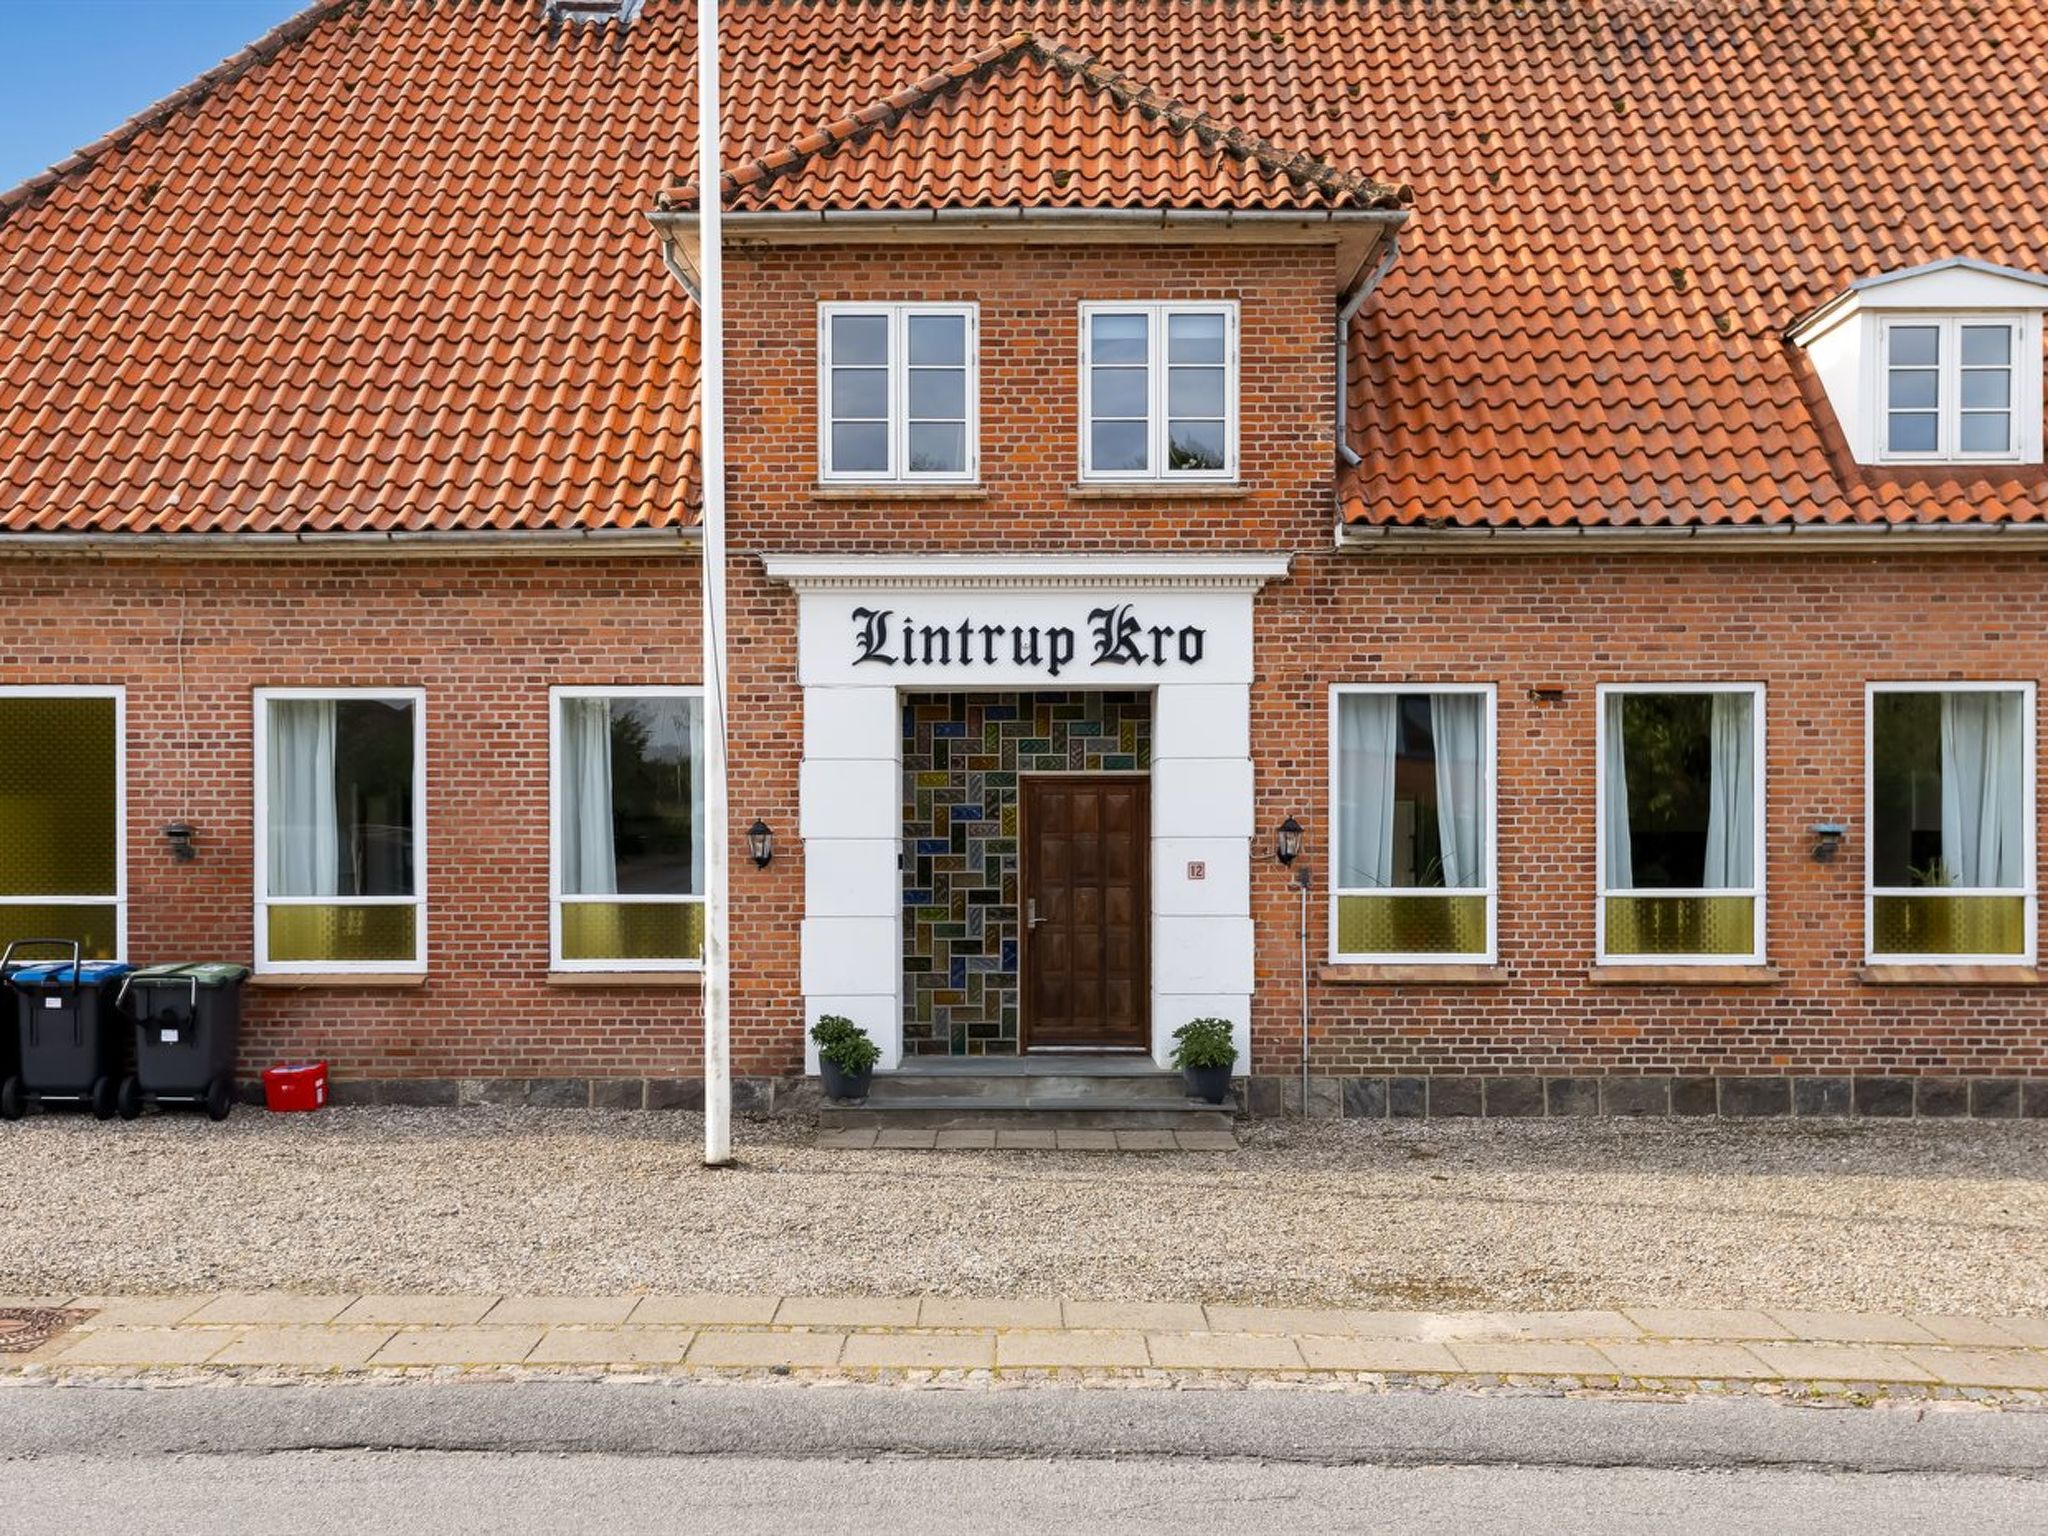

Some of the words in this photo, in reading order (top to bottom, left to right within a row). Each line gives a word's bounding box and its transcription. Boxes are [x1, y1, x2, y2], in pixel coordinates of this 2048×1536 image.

[852, 606, 1075, 677] Lintrup
[1086, 603, 1206, 667] Kro
[1190, 865, 1203, 877] 12
